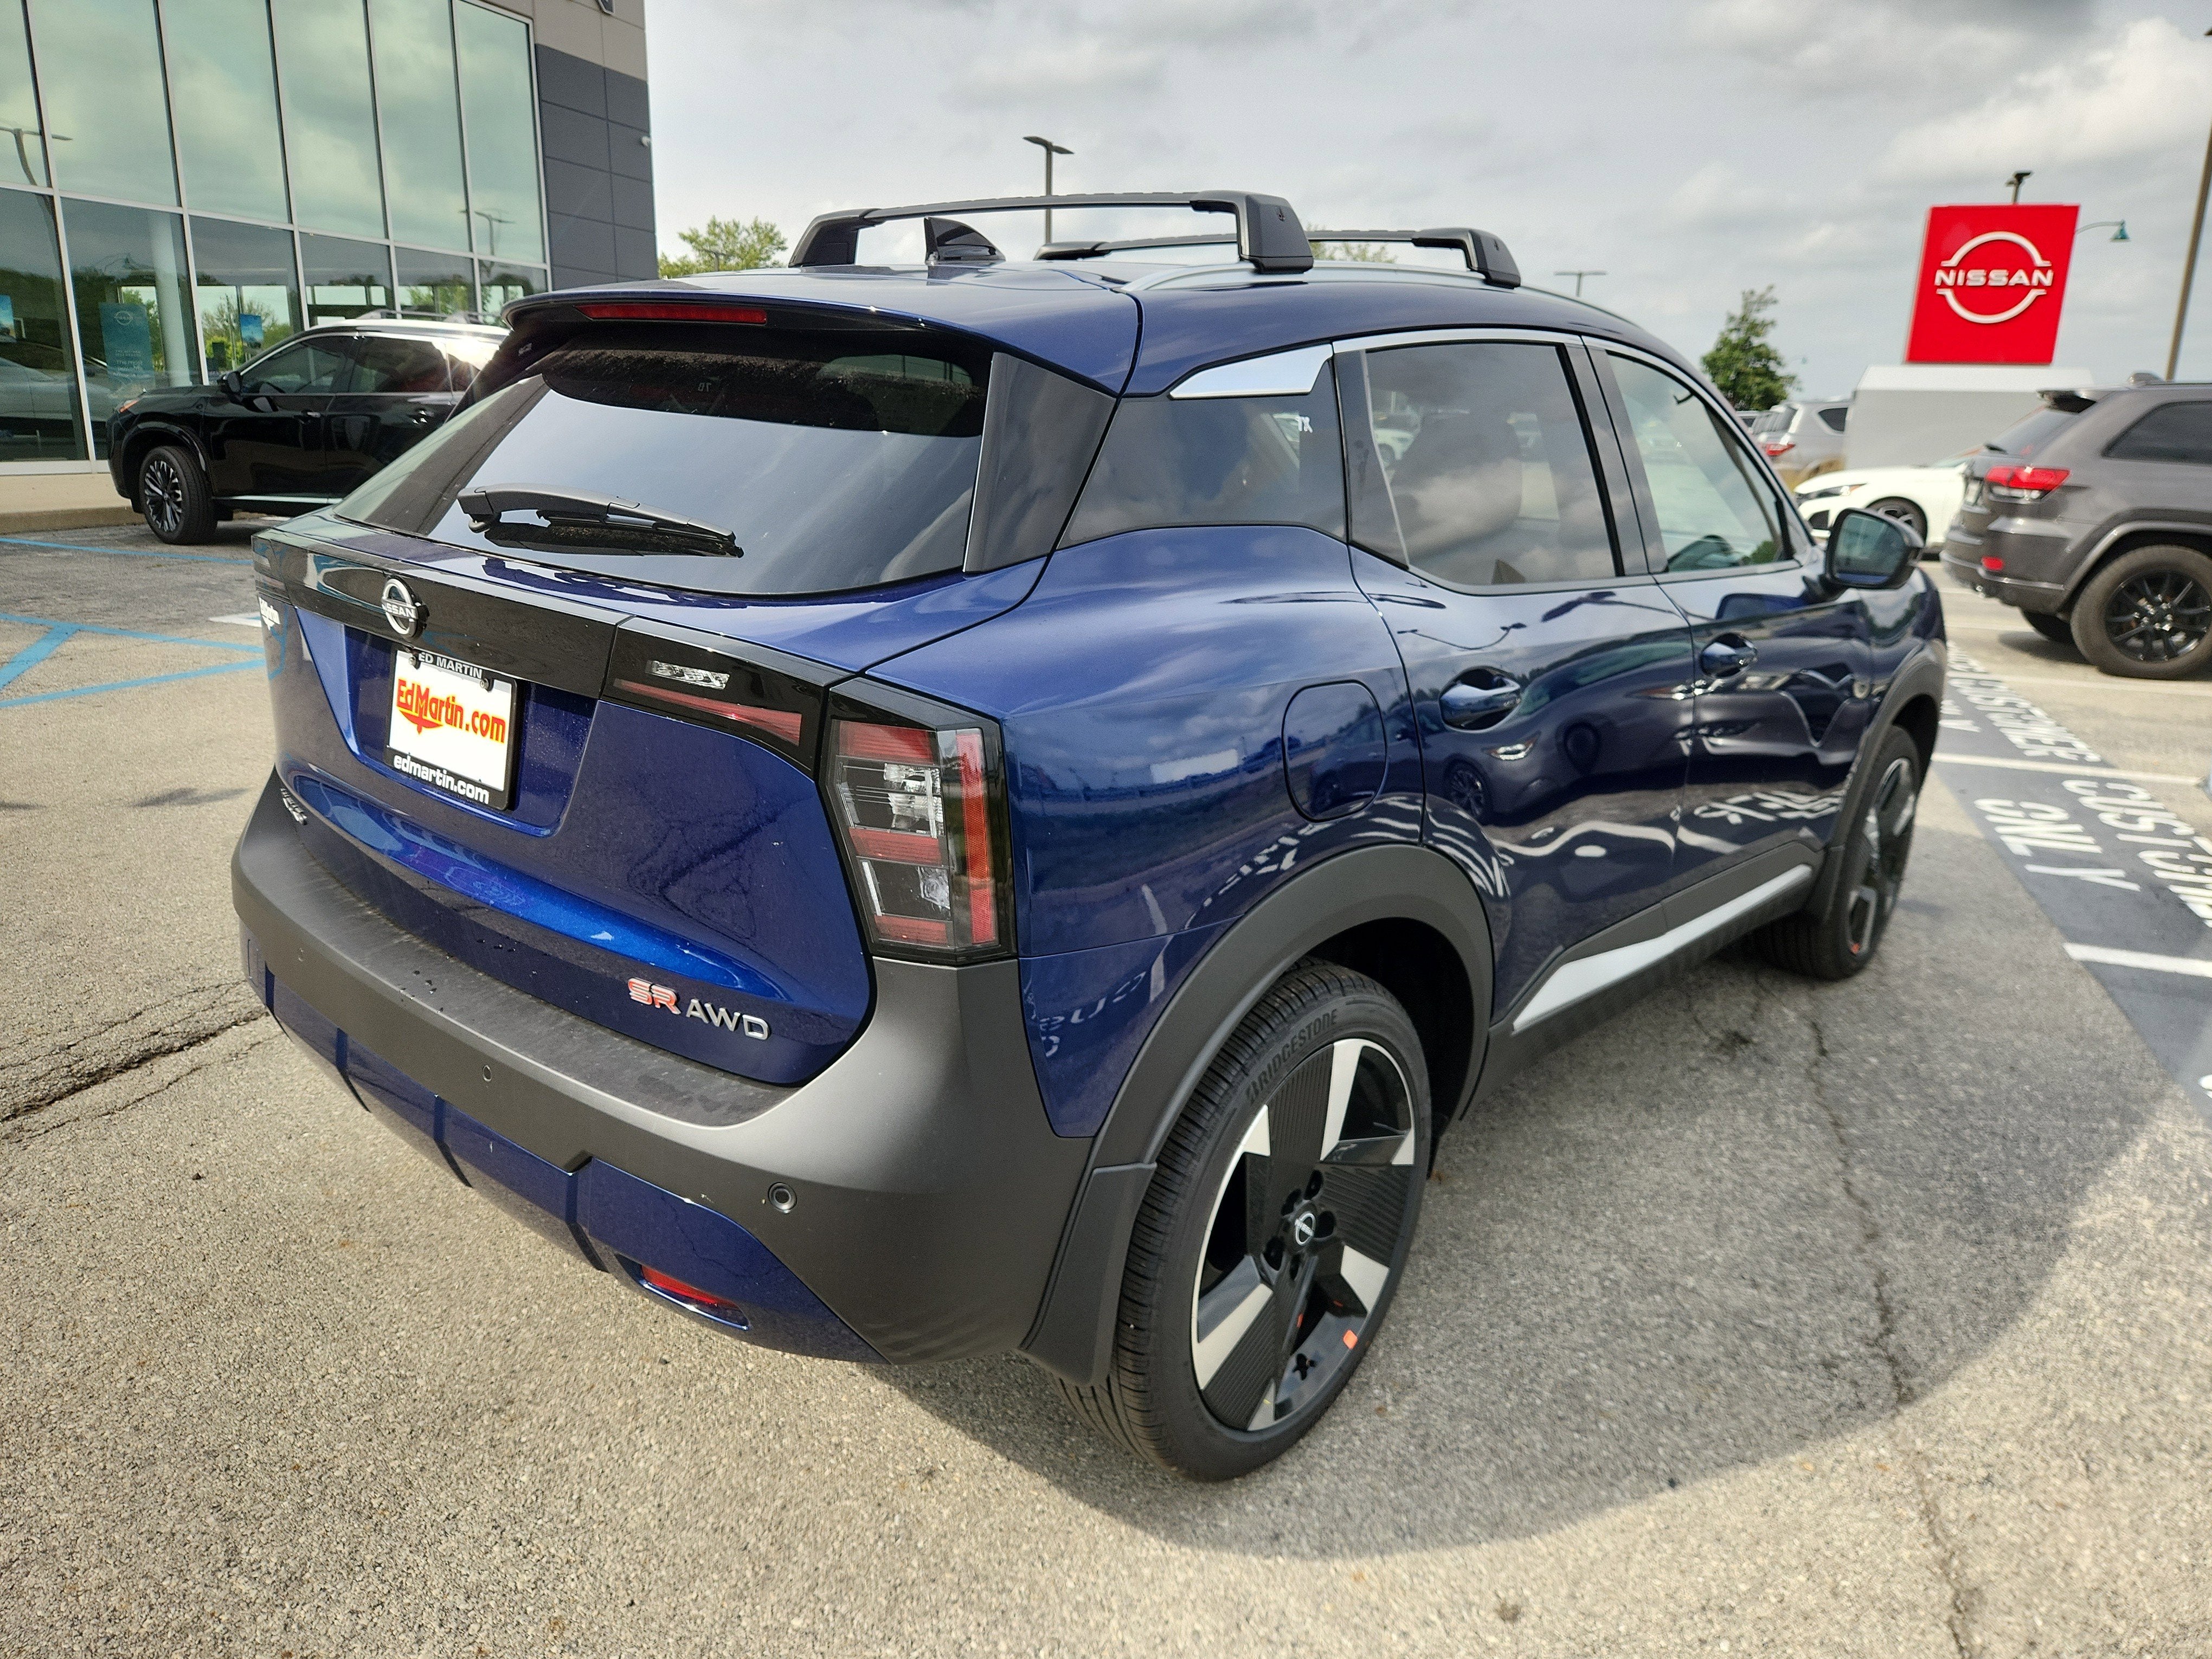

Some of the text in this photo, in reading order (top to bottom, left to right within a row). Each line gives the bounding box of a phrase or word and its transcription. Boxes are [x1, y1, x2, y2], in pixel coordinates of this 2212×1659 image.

[1934, 269, 2054, 287] NISSAN
[418, 652, 483, 679] ED MARTIN
[394, 754, 490, 805] edmartin.com
[1973, 799, 2141, 892] ONLY
[627, 977, 771, 1040] SR AWD
[1246, 1008, 1338, 1105] BRIDGESTONE
